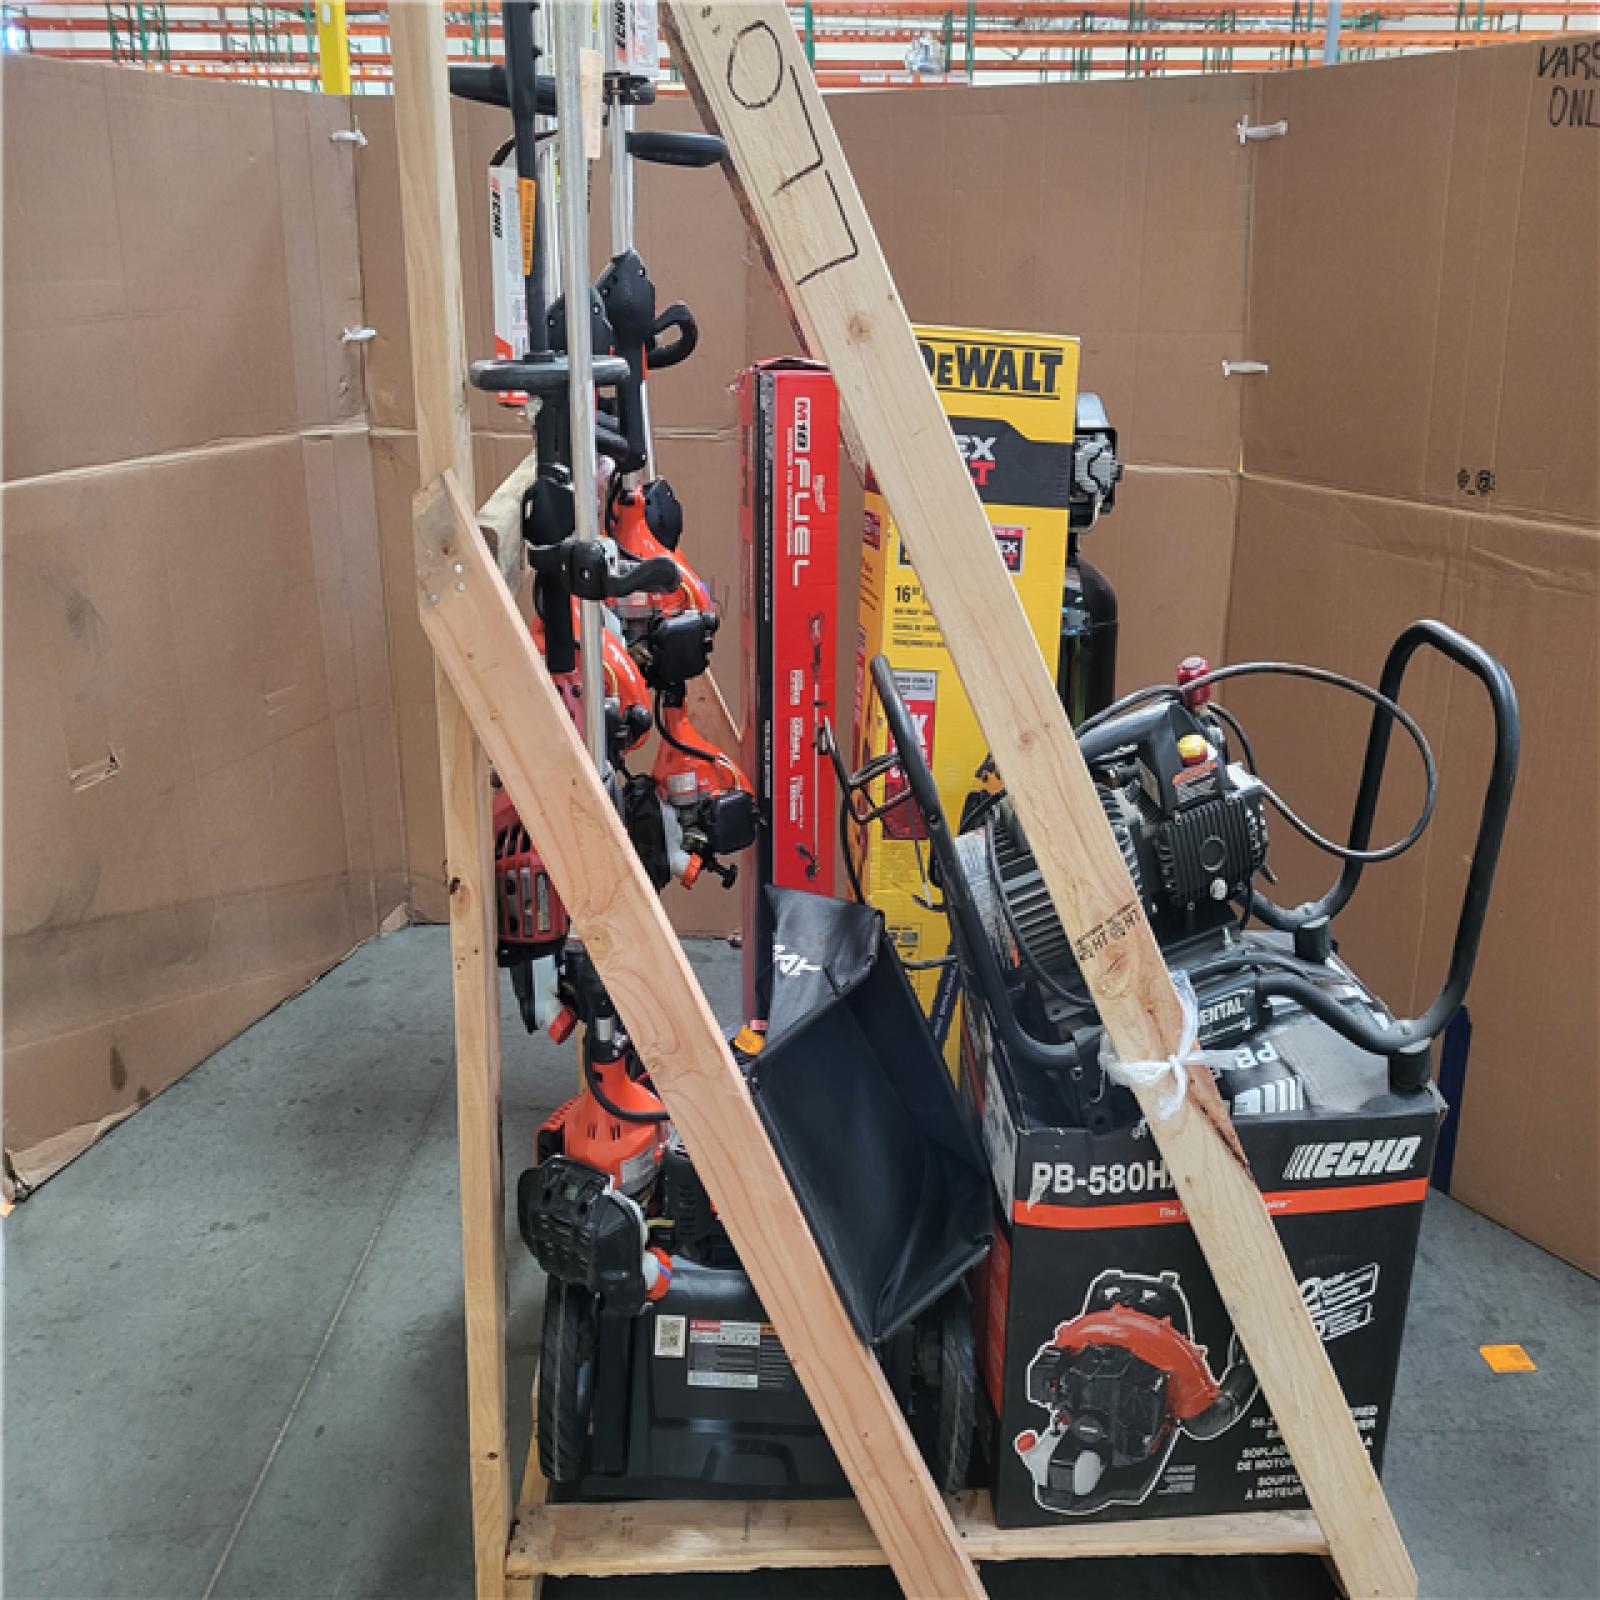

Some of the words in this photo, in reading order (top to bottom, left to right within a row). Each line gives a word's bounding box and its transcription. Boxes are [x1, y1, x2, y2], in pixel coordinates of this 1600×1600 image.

[796, 400, 809, 450] M18
[793, 458, 811, 588] FUEL
[1031, 1158, 1175, 1195] PB-580H
[1319, 1135, 1422, 1178] ECHO
